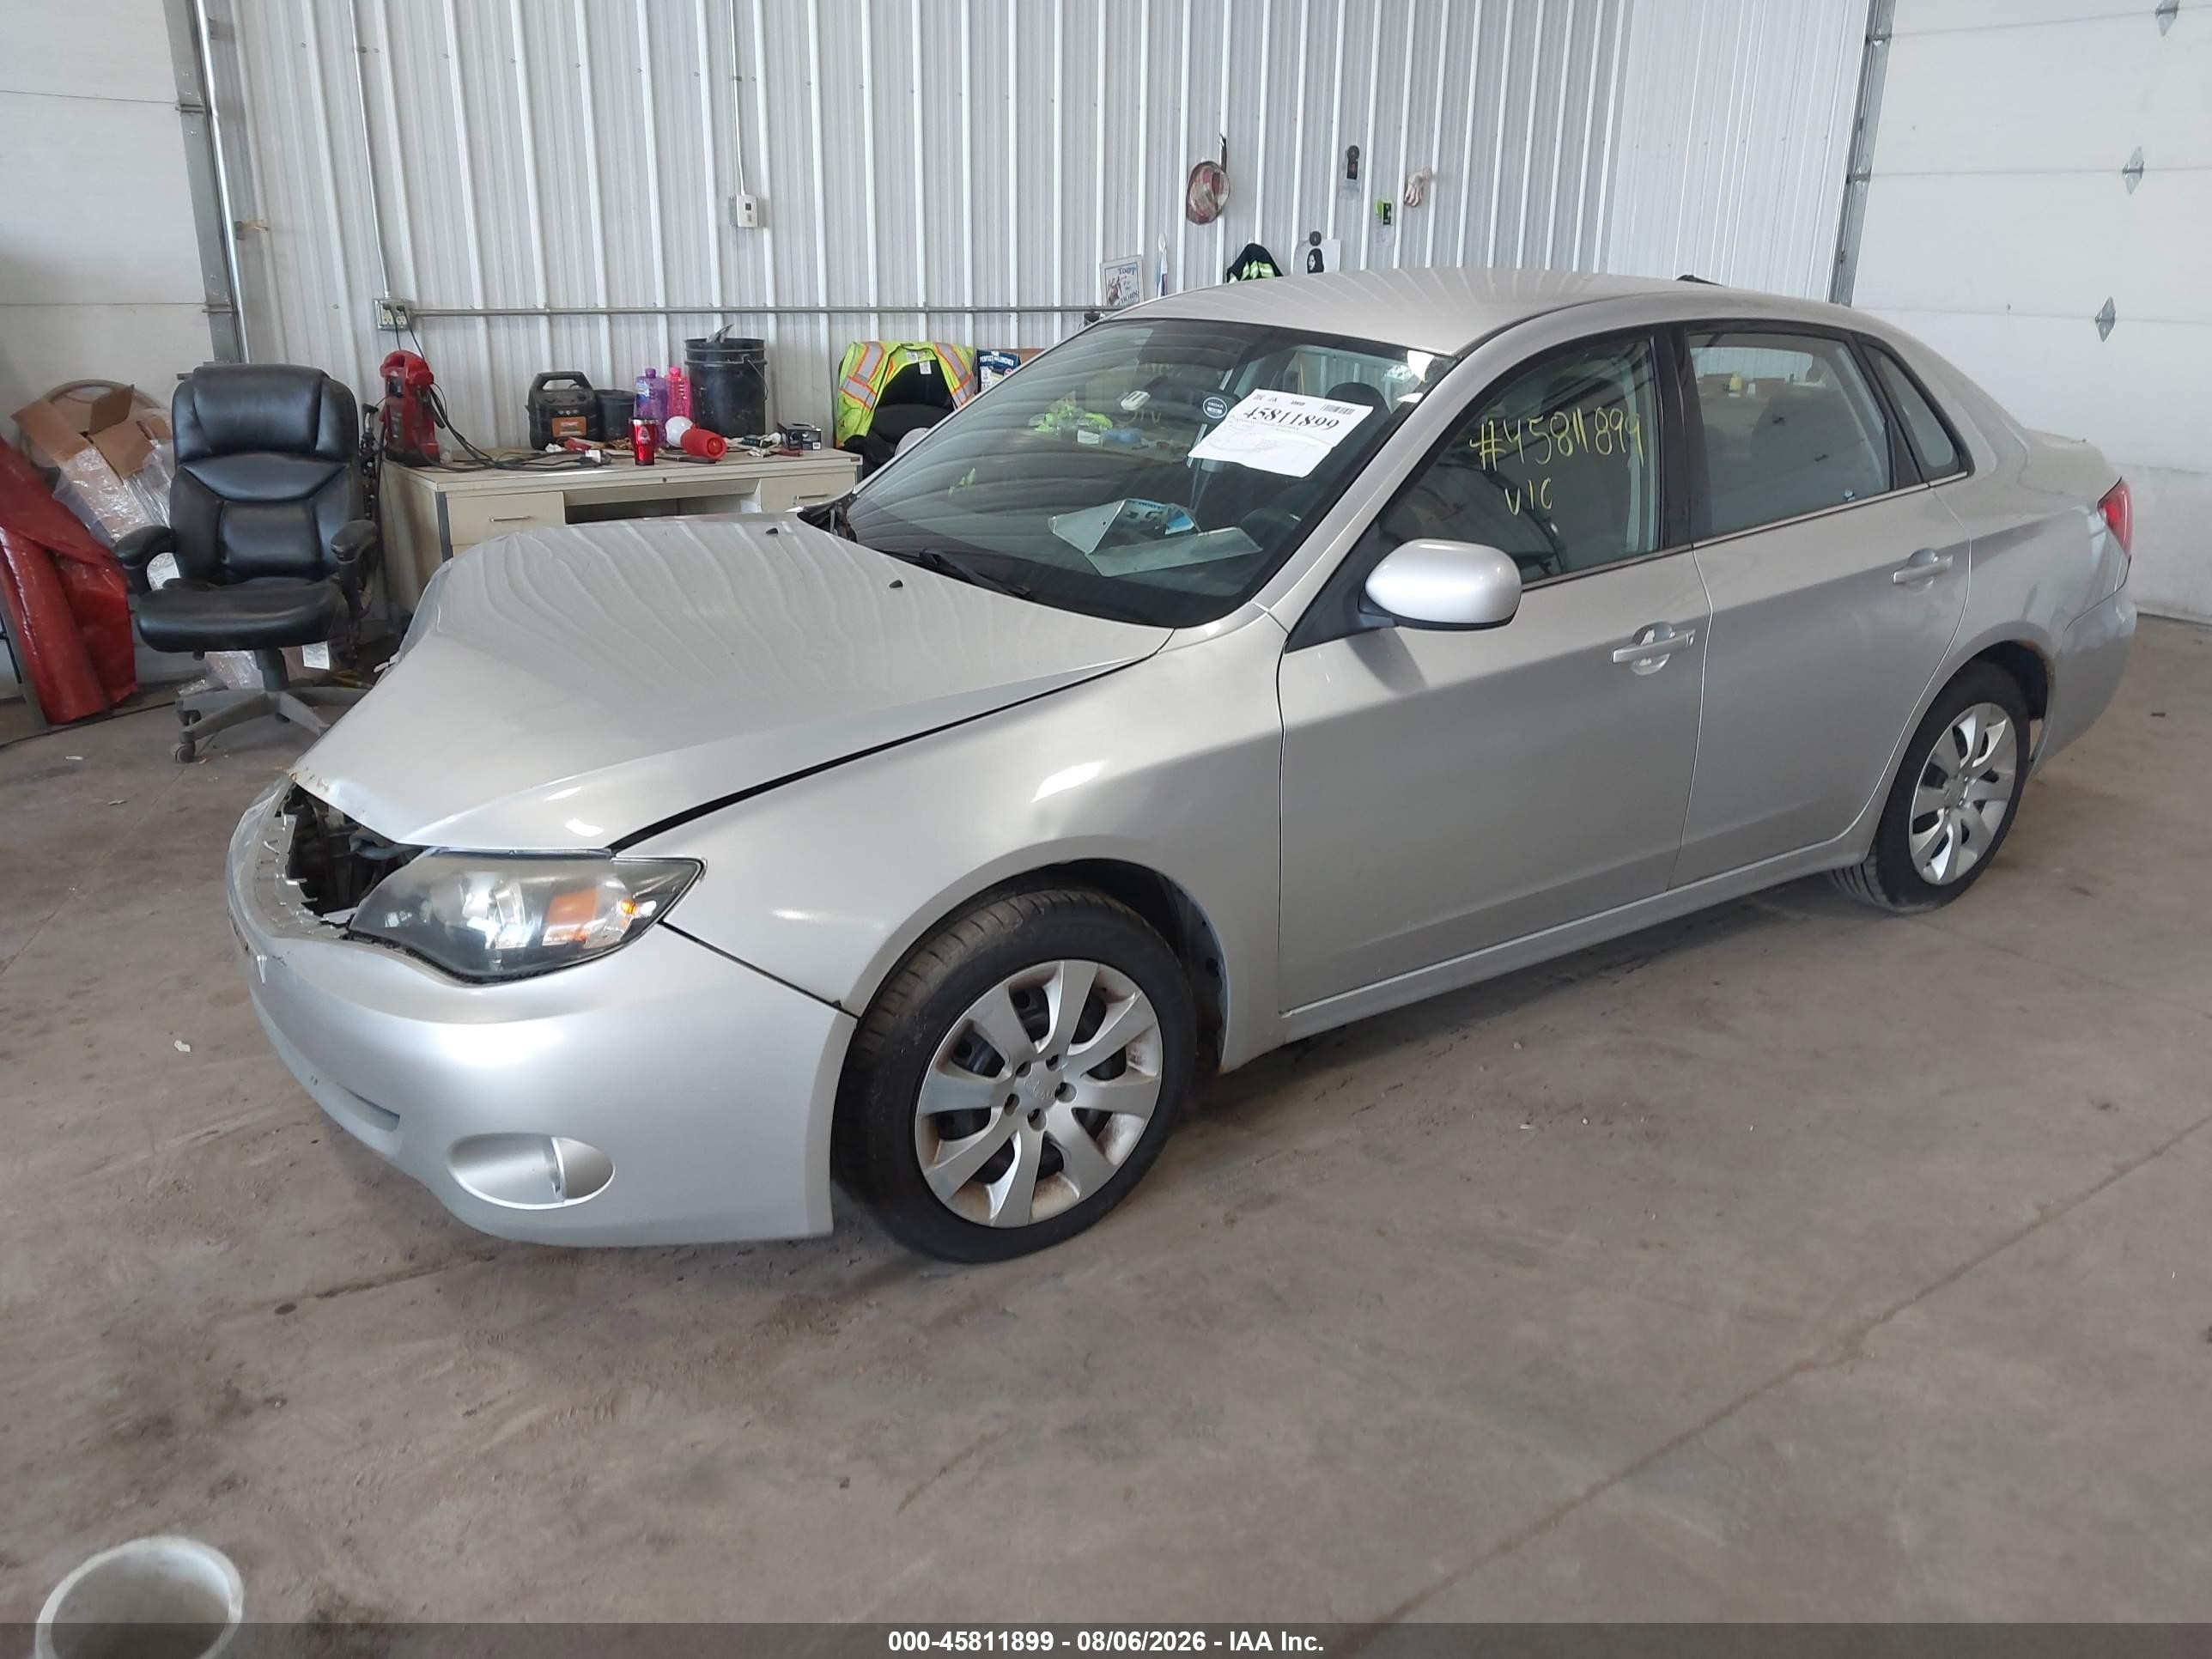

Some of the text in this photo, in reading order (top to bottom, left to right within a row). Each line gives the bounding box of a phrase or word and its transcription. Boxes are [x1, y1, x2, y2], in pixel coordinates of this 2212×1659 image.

[1243, 407, 1340, 430] 45811899
[1469, 406, 1644, 471] #45811899
[1504, 477, 1553, 516] VIC
